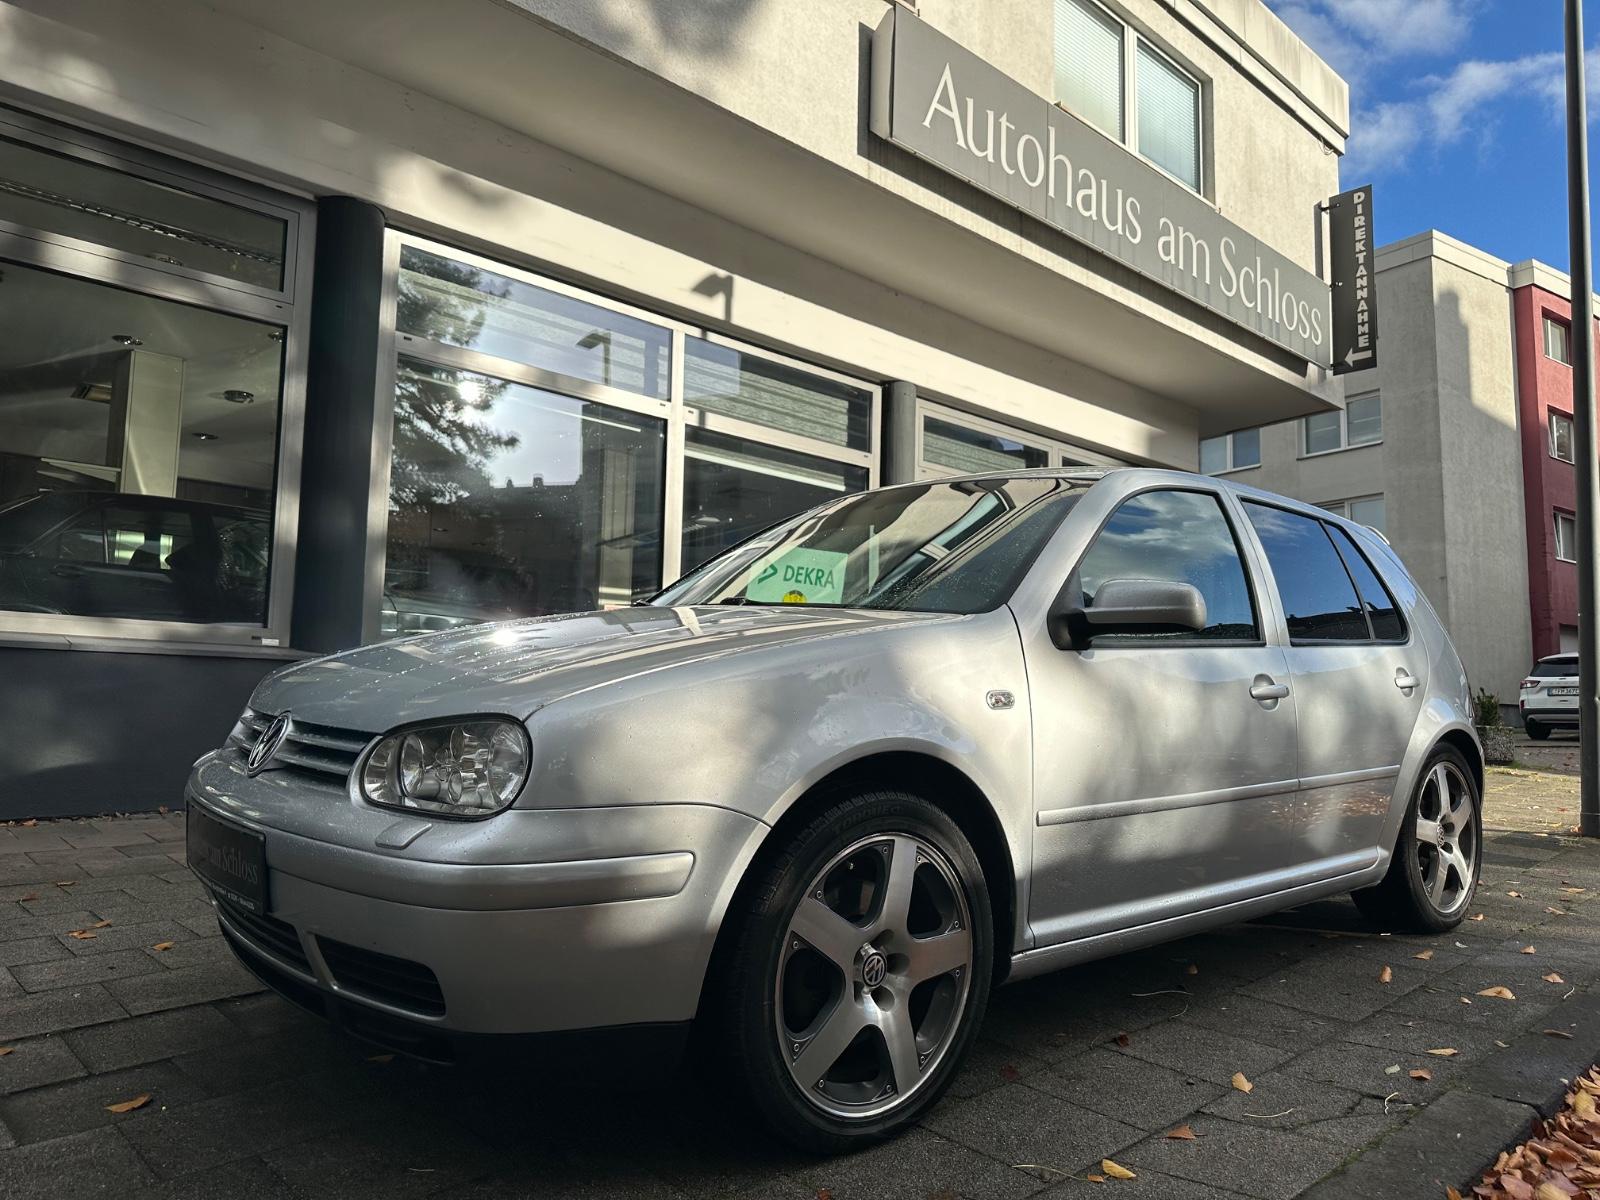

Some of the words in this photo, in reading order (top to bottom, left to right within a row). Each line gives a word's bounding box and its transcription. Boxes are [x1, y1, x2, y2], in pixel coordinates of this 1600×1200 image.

[922, 62, 1142, 246] Autohaus
[1157, 216, 1211, 285] am
[1219, 236, 1323, 346] Schloss
[1353, 191, 1370, 348] DIREKTANNAHME
[783, 564, 835, 590] DEKRA
[222, 846, 258, 885] Schloss
